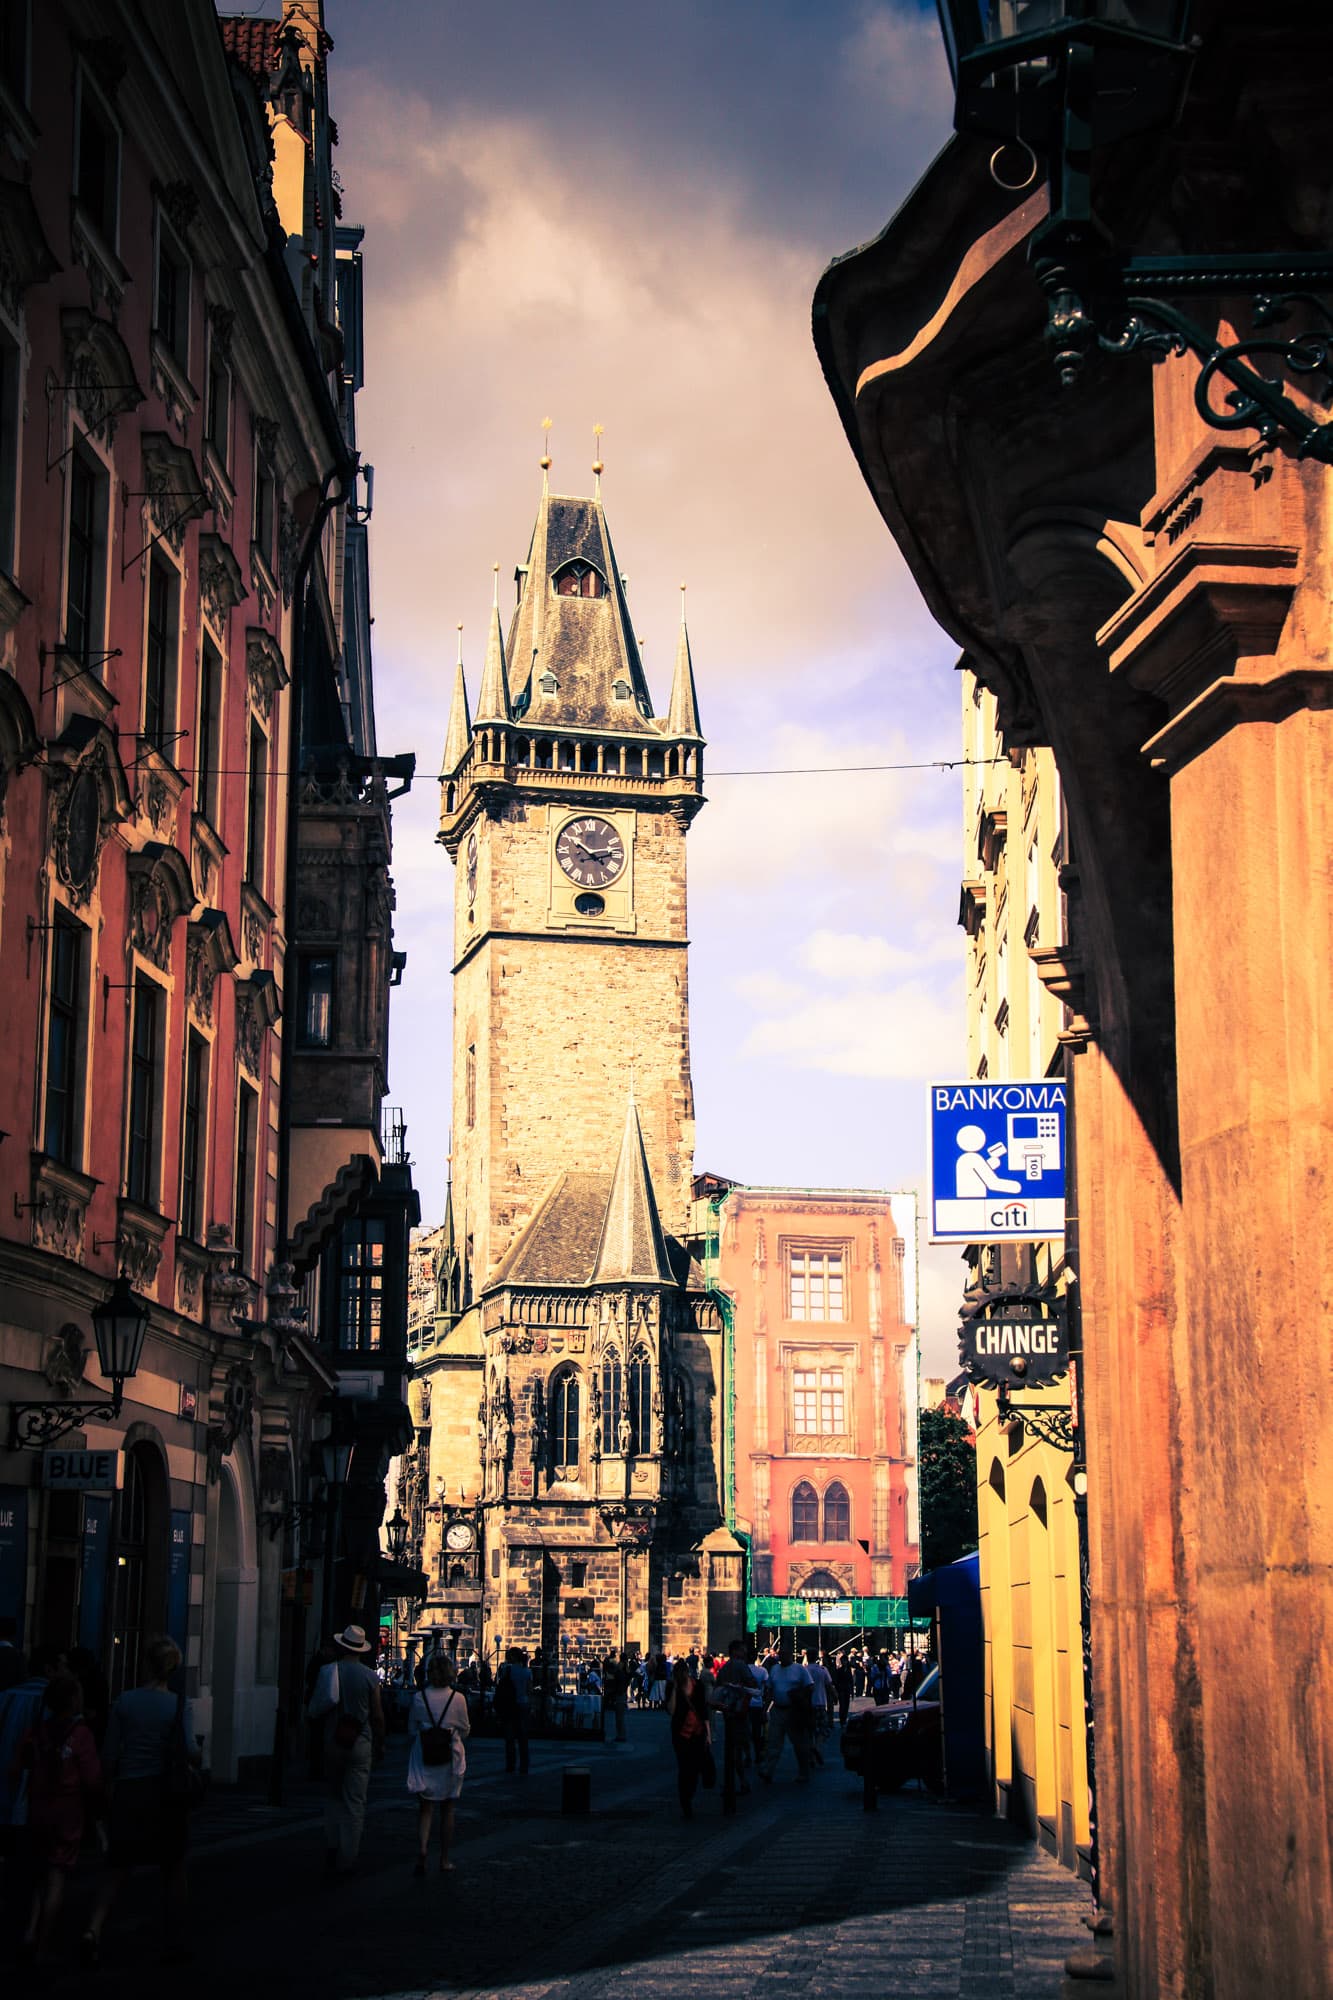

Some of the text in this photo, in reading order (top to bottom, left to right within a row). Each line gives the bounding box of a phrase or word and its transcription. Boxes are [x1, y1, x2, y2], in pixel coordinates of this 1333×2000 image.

[936, 1087, 1066, 1111] BANKOMA
[1030, 1159, 1038, 1177] 100
[990, 1207, 1027, 1227] citi
[975, 1325, 1059, 1354] CHANGE
[50, 1455, 109, 1478] BLUE
